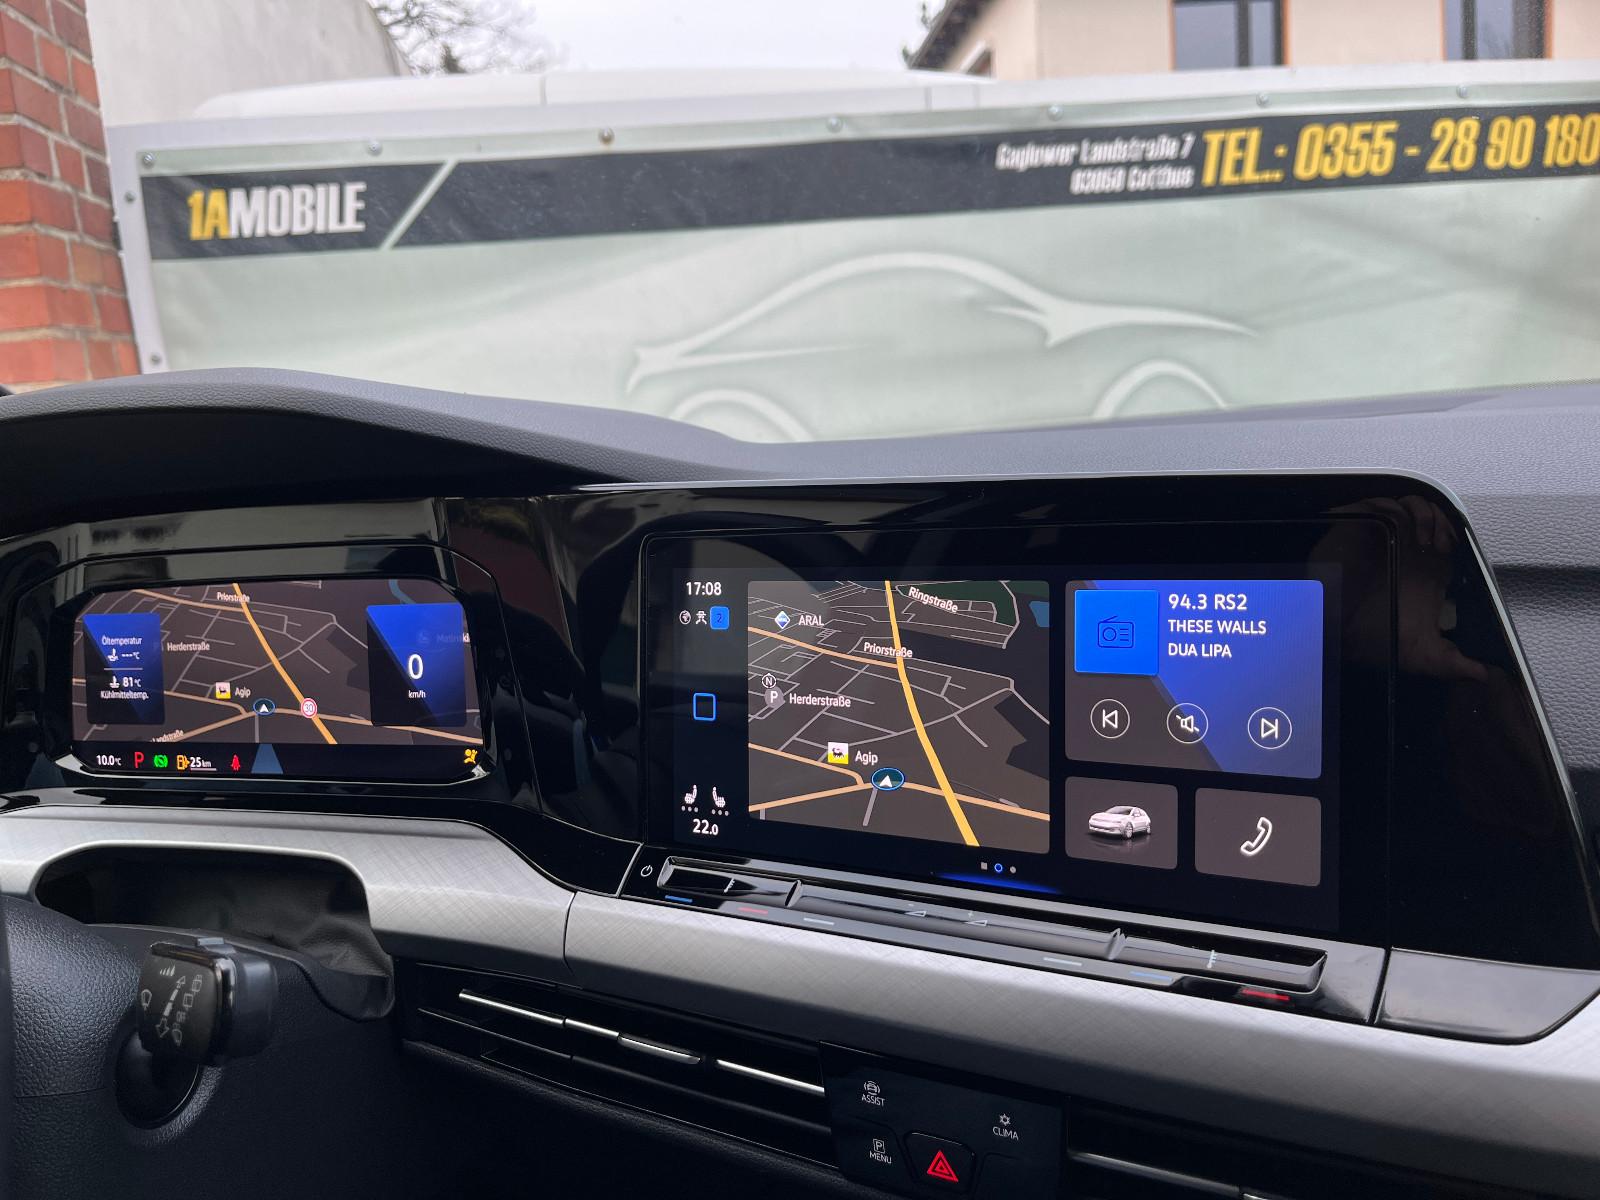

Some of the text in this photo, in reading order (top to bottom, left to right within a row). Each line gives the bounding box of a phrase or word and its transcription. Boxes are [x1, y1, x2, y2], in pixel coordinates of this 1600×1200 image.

[1180, 132, 1197, 159] 7
[1293, 121, 1400, 181] 0355
[1425, 117, 1481, 173] 28
[1484, 115, 1537, 171] 90
[1543, 112, 1600, 168] 180
[686, 582, 722, 596] 17:08
[216, 591, 251, 604] Priorstraße
[907, 586, 959, 613] Ringstraße
[1168, 594, 1248, 610] 94.3 RS2
[798, 615, 825, 626] ARAL
[1168, 619, 1267, 635] THESE WALLS
[166, 642, 211, 652] Herderstraße
[863, 641, 913, 659] Priorstraße
[1168, 643, 1232, 659] DUA LIPA
[407, 653, 424, 680] 0
[765, 676, 773, 686] N
[234, 686, 251, 698] Agip
[408, 689, 426, 699] km/h
[770, 690, 779, 703] P
[789, 693, 851, 708] Herderstraße
[134, 751, 145, 769] P
[854, 750, 879, 766] Agip
[692, 818, 719, 836] 22.0
[861, 1094, 886, 1106] ASSIST
[992, 1126, 1019, 1141] CLIMA
[869, 1151, 892, 1165] MENU
